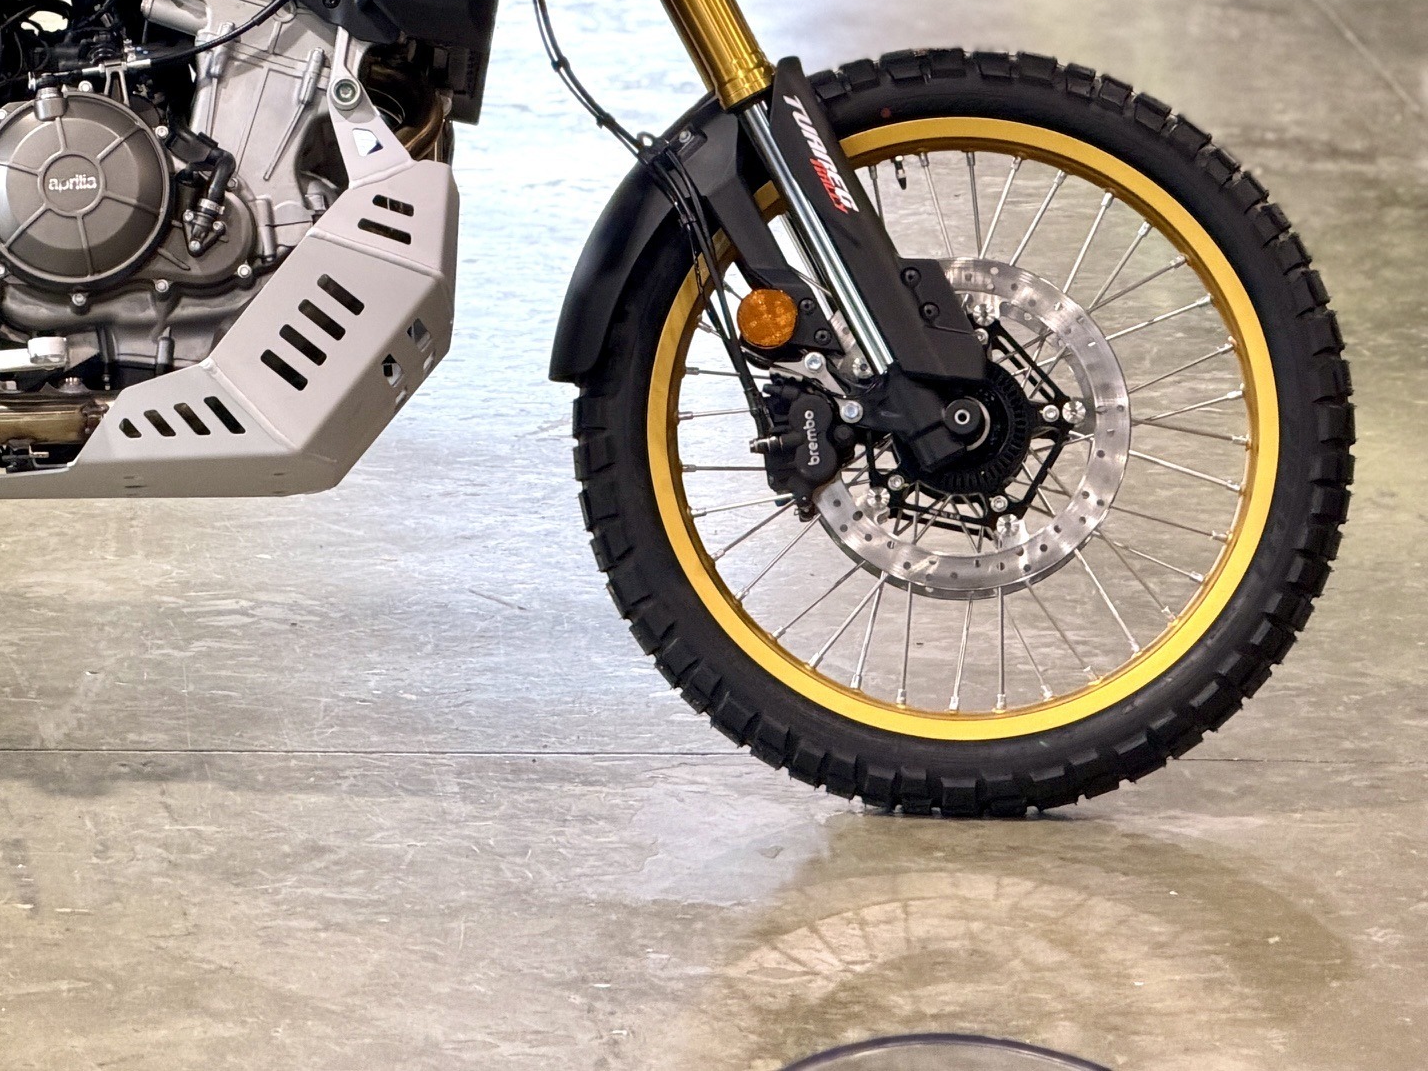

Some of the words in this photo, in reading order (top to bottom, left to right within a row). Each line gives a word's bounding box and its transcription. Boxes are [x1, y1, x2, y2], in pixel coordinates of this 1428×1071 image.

[782, 95, 859, 212] TUAREG
[48, 174, 97, 193] aprilia
[803, 410, 820, 466] brembo
